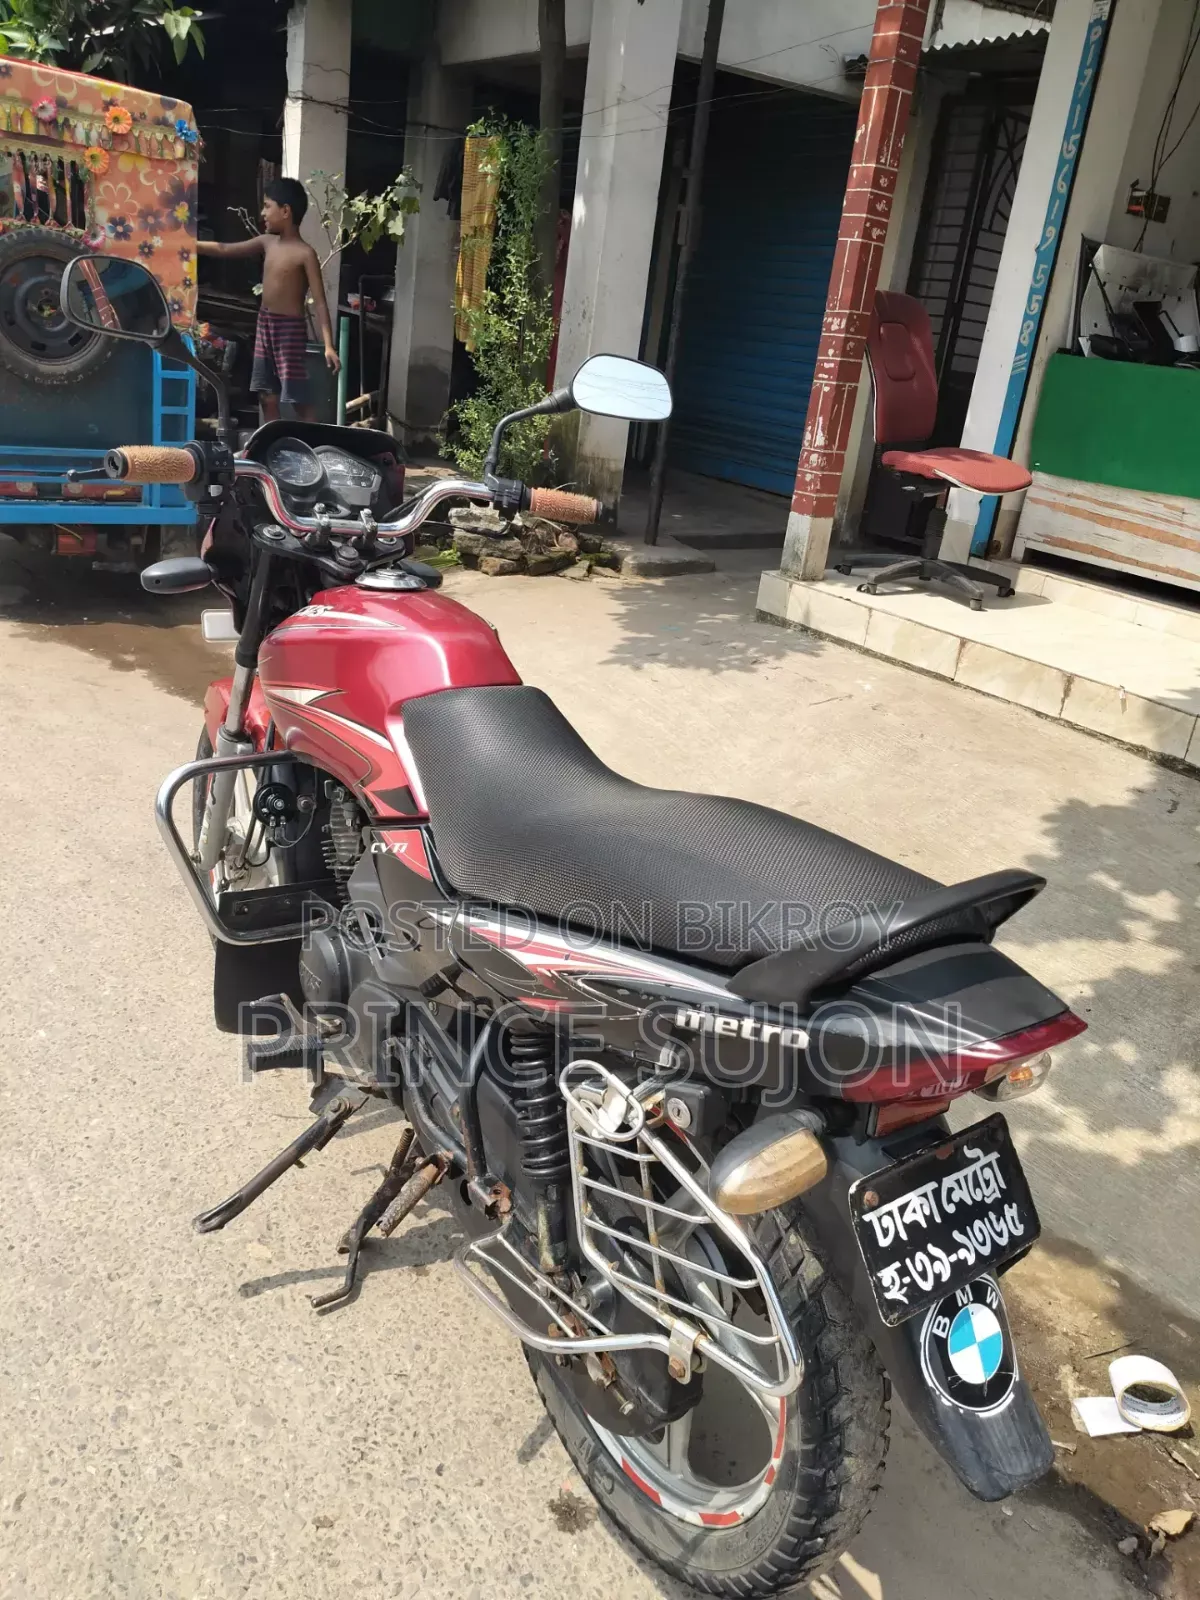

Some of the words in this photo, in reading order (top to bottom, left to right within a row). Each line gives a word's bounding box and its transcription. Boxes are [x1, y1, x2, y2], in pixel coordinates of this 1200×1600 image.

[675, 1007, 812, 1050] metro
[861, 1180, 942, 1248] ঢাকা
[940, 1144, 1007, 1214] মেট্রো
[931, 1284, 999, 1339] BMW
